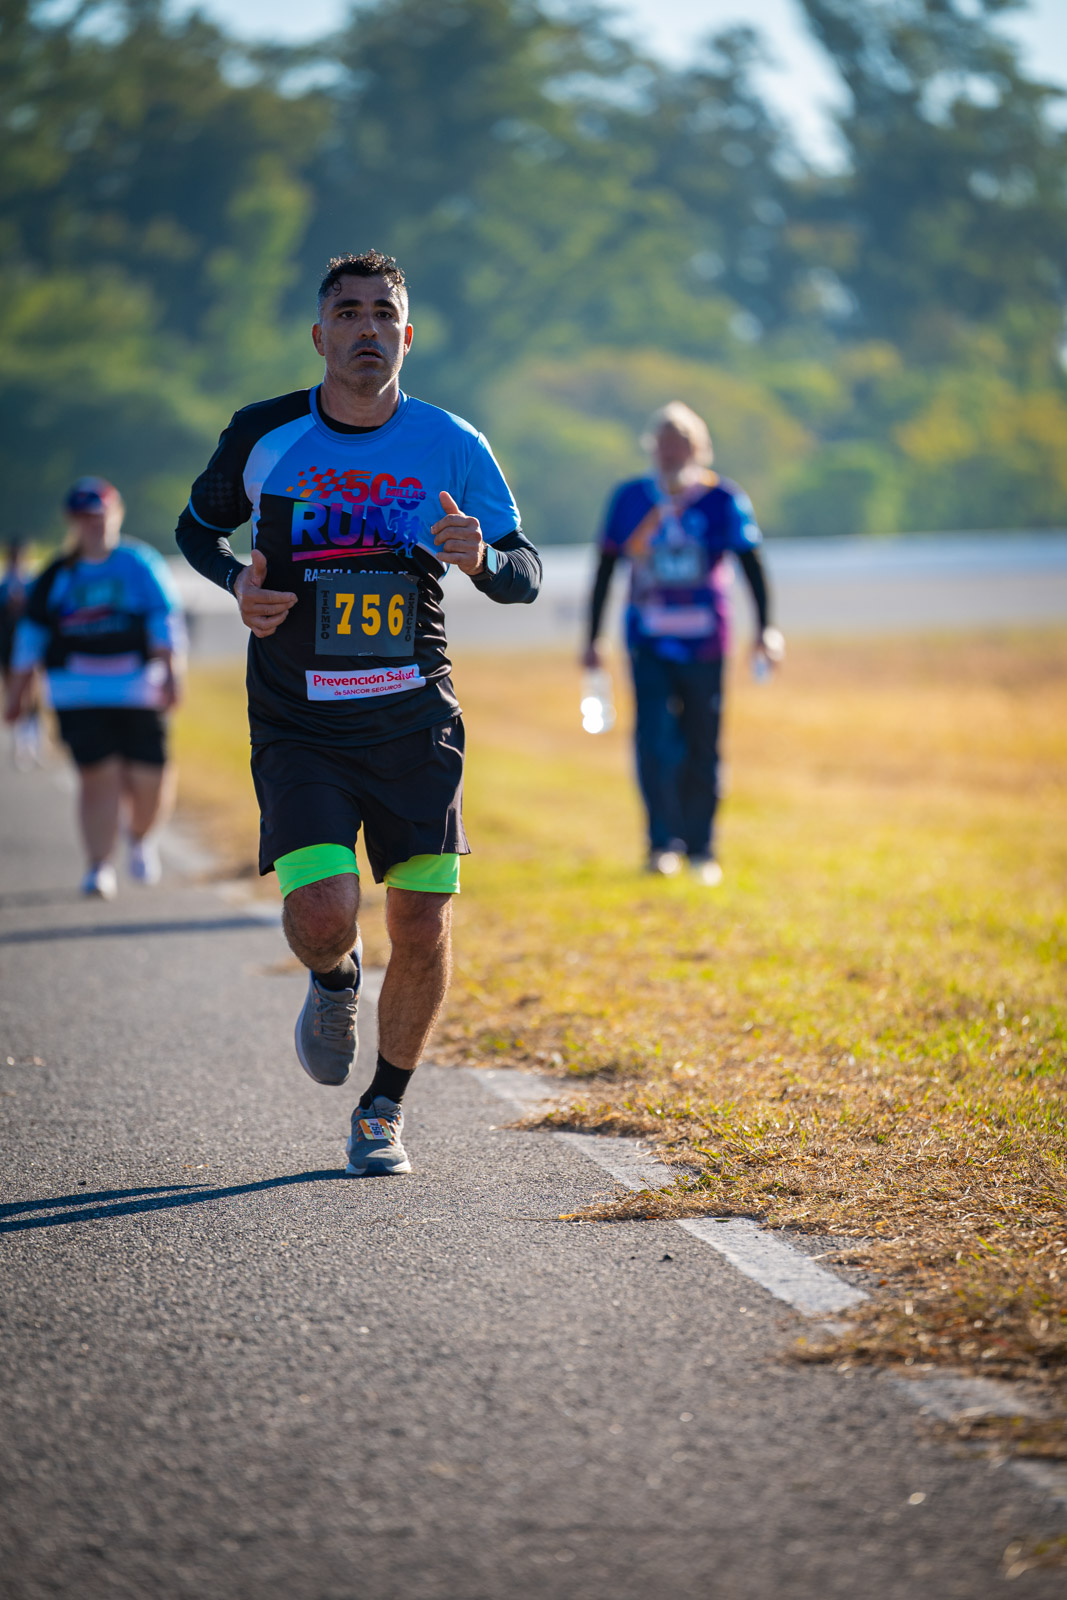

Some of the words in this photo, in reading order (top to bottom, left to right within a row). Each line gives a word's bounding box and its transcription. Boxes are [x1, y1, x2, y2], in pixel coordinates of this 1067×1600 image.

[385, 487, 426, 501] MILLAS
[291, 501, 402, 546] RUN
[320, 590, 331, 640] TIEMPO
[335, 593, 405, 636] 756
[404, 592, 416, 642] EXACTO
[313, 674, 385, 687] Prevención
[386, 668, 415, 682] Salud
[342, 688, 370, 696] SANCOR
[371, 683, 402, 693] SEGUROS
